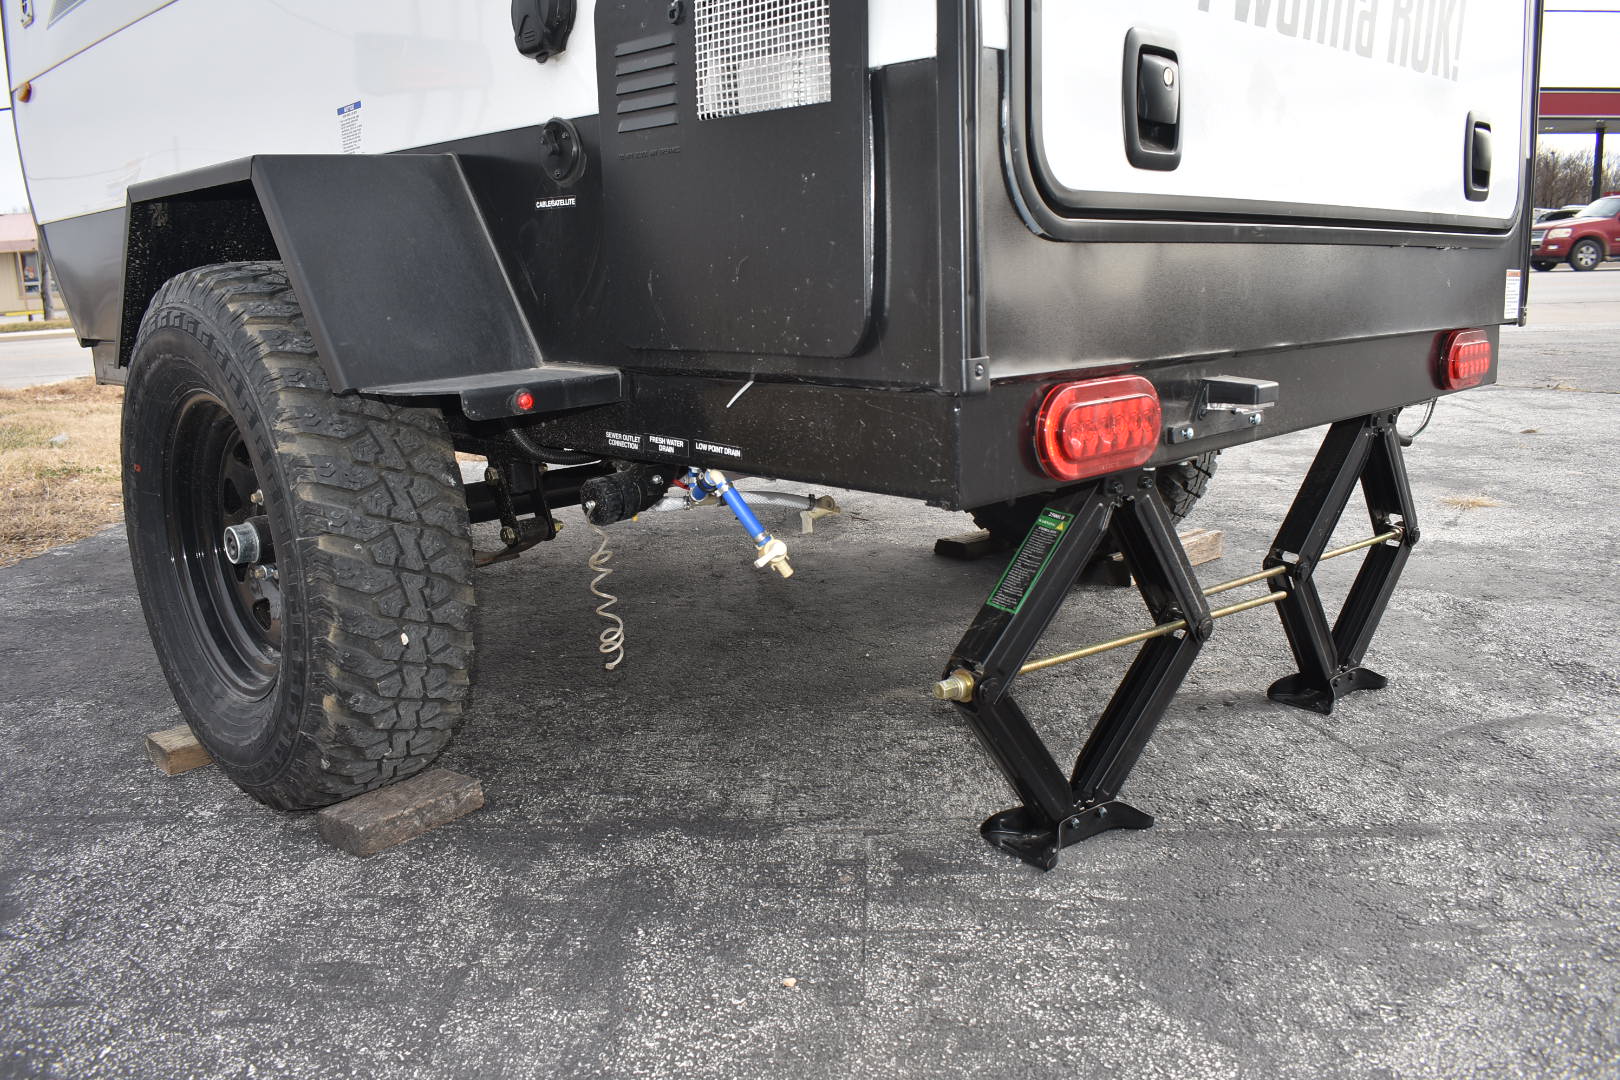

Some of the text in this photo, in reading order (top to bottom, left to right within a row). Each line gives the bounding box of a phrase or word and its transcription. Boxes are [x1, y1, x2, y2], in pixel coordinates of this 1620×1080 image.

[605, 431, 641, 443] SEWER OUTLET
[649, 436, 684, 448] FRESH WATER
[608, 439, 639, 450] CONNECTION
[658, 444, 675, 454] DRAIN
[695, 442, 742, 457] LOW POINT DRAIN
